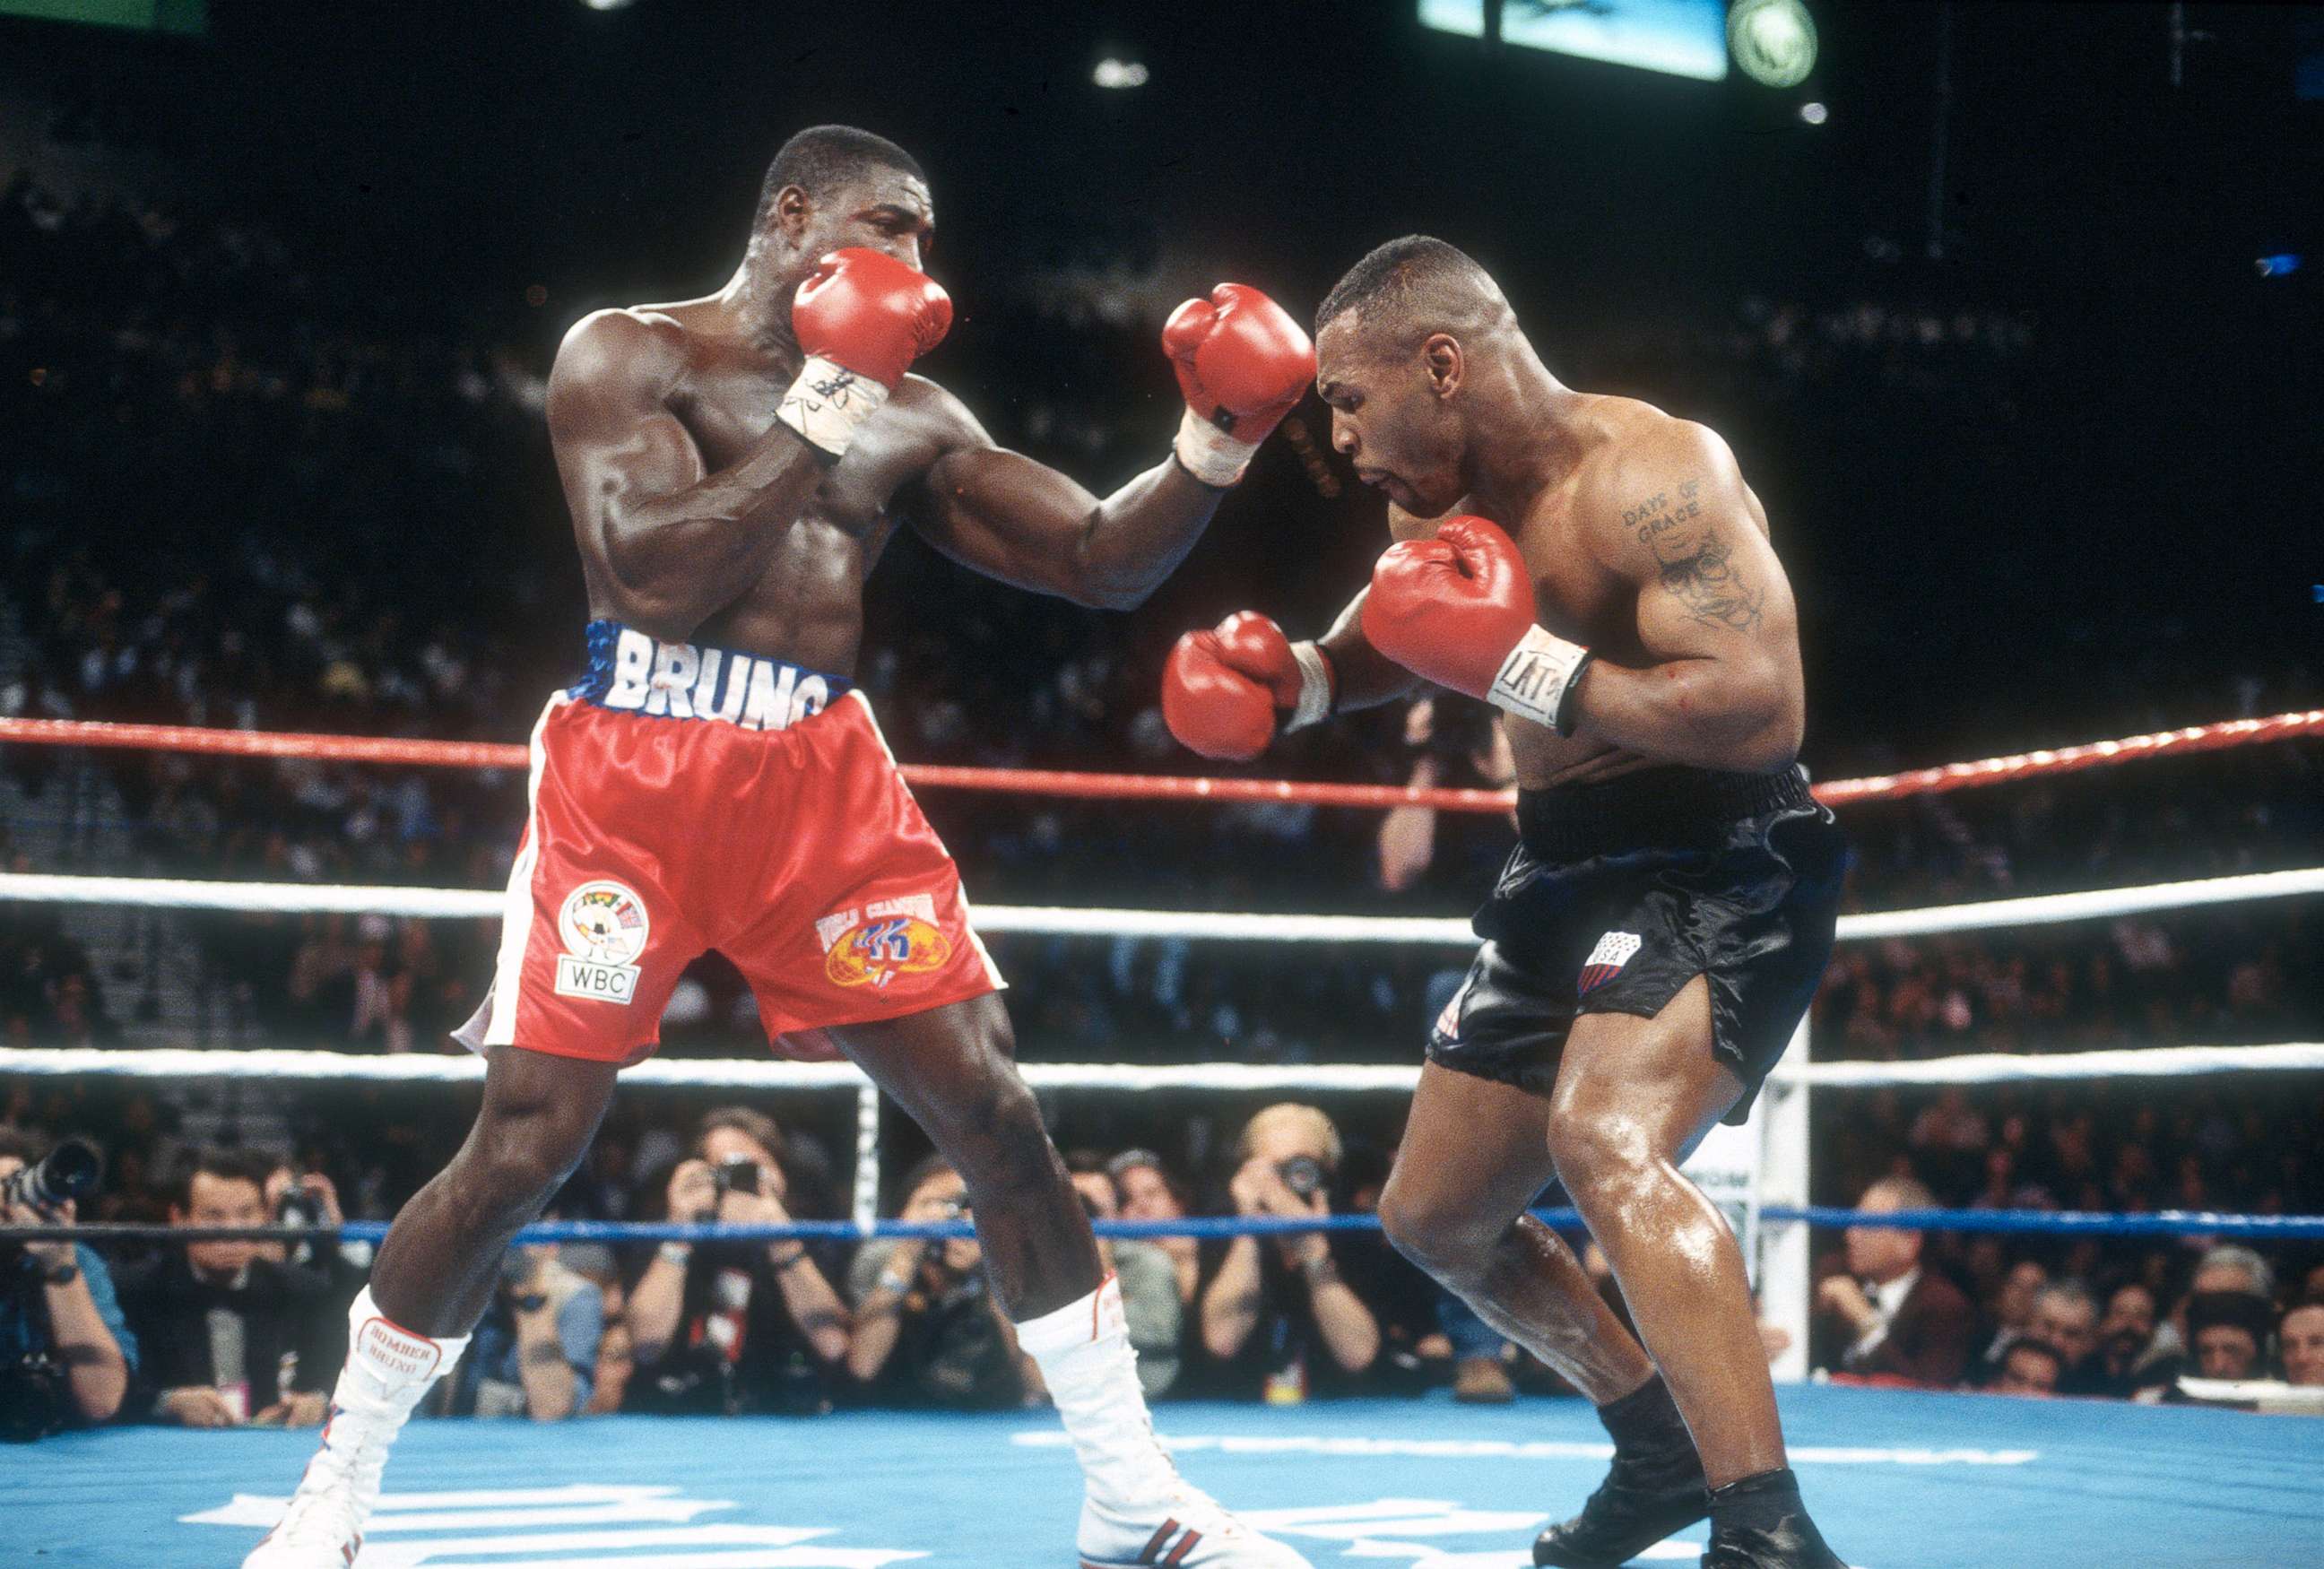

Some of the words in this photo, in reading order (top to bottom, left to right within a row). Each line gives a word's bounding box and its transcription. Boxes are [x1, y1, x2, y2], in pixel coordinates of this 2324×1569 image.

[1638, 501, 1701, 543] GRACE
[603, 628, 828, 732] BRUNO
[1593, 948, 1620, 962] USA
[572, 965, 626, 993] WBC
